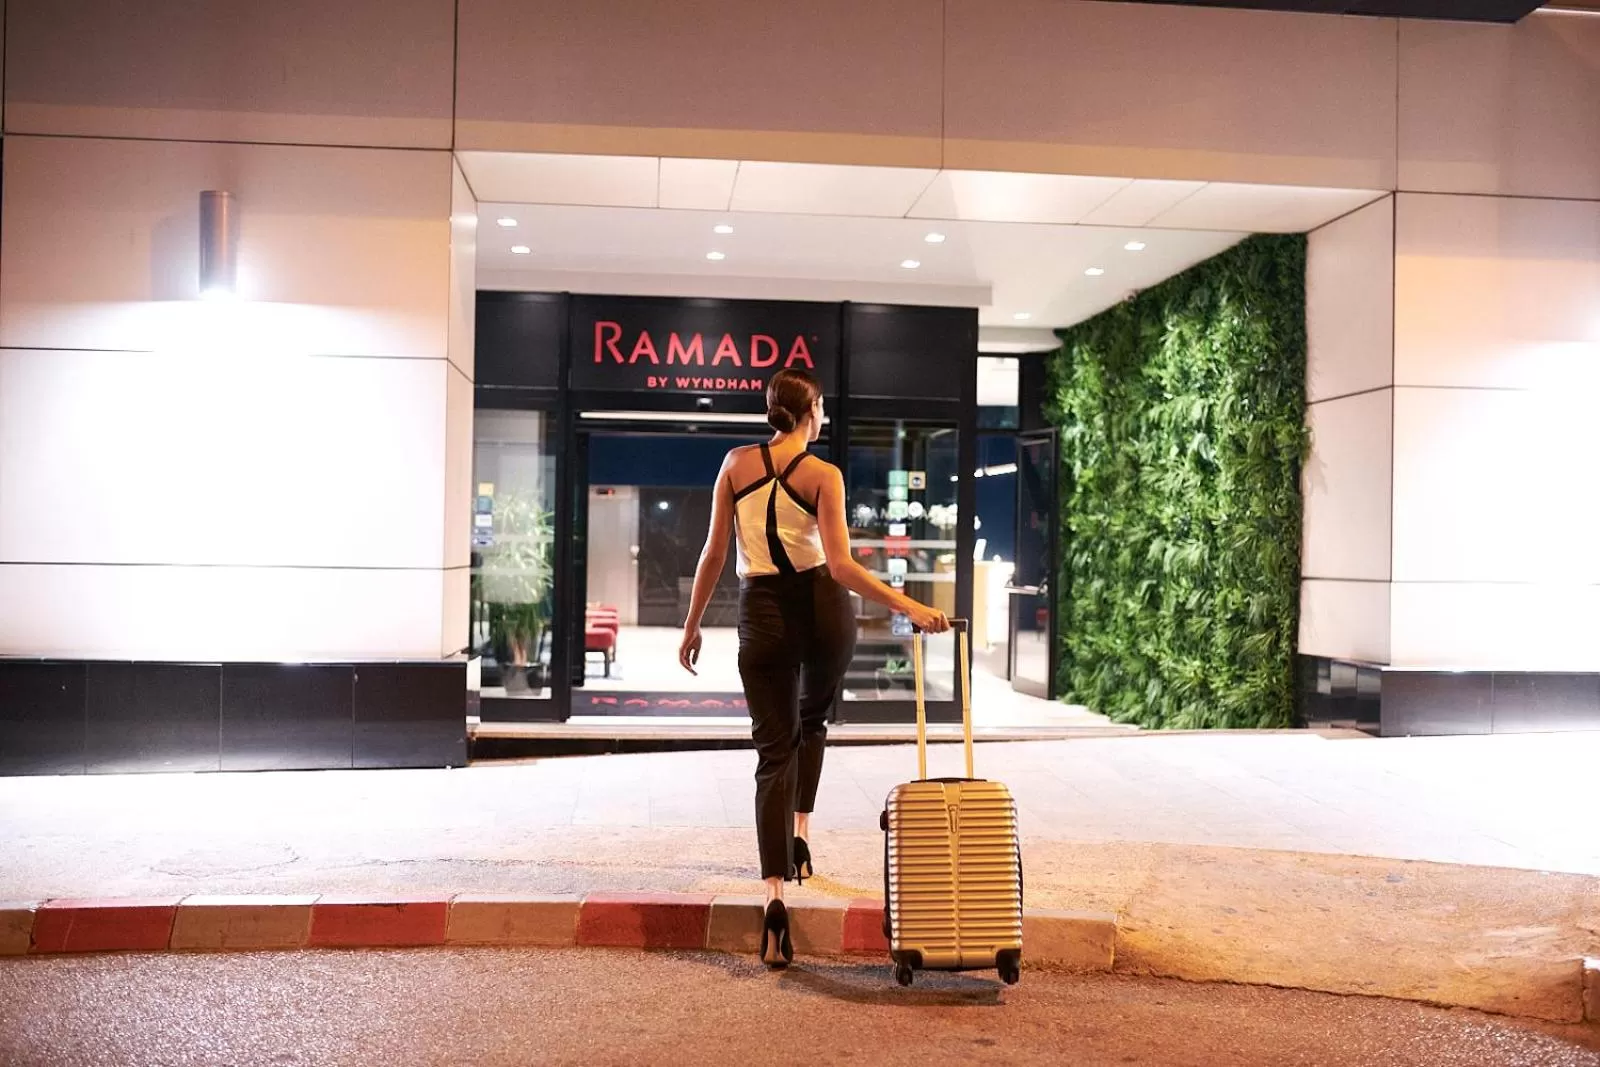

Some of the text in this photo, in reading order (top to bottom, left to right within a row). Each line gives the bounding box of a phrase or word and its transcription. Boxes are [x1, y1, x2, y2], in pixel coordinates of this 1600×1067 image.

[593, 320, 815, 369] RAMADA
[646, 375, 764, 391] BY WYNDHAM
